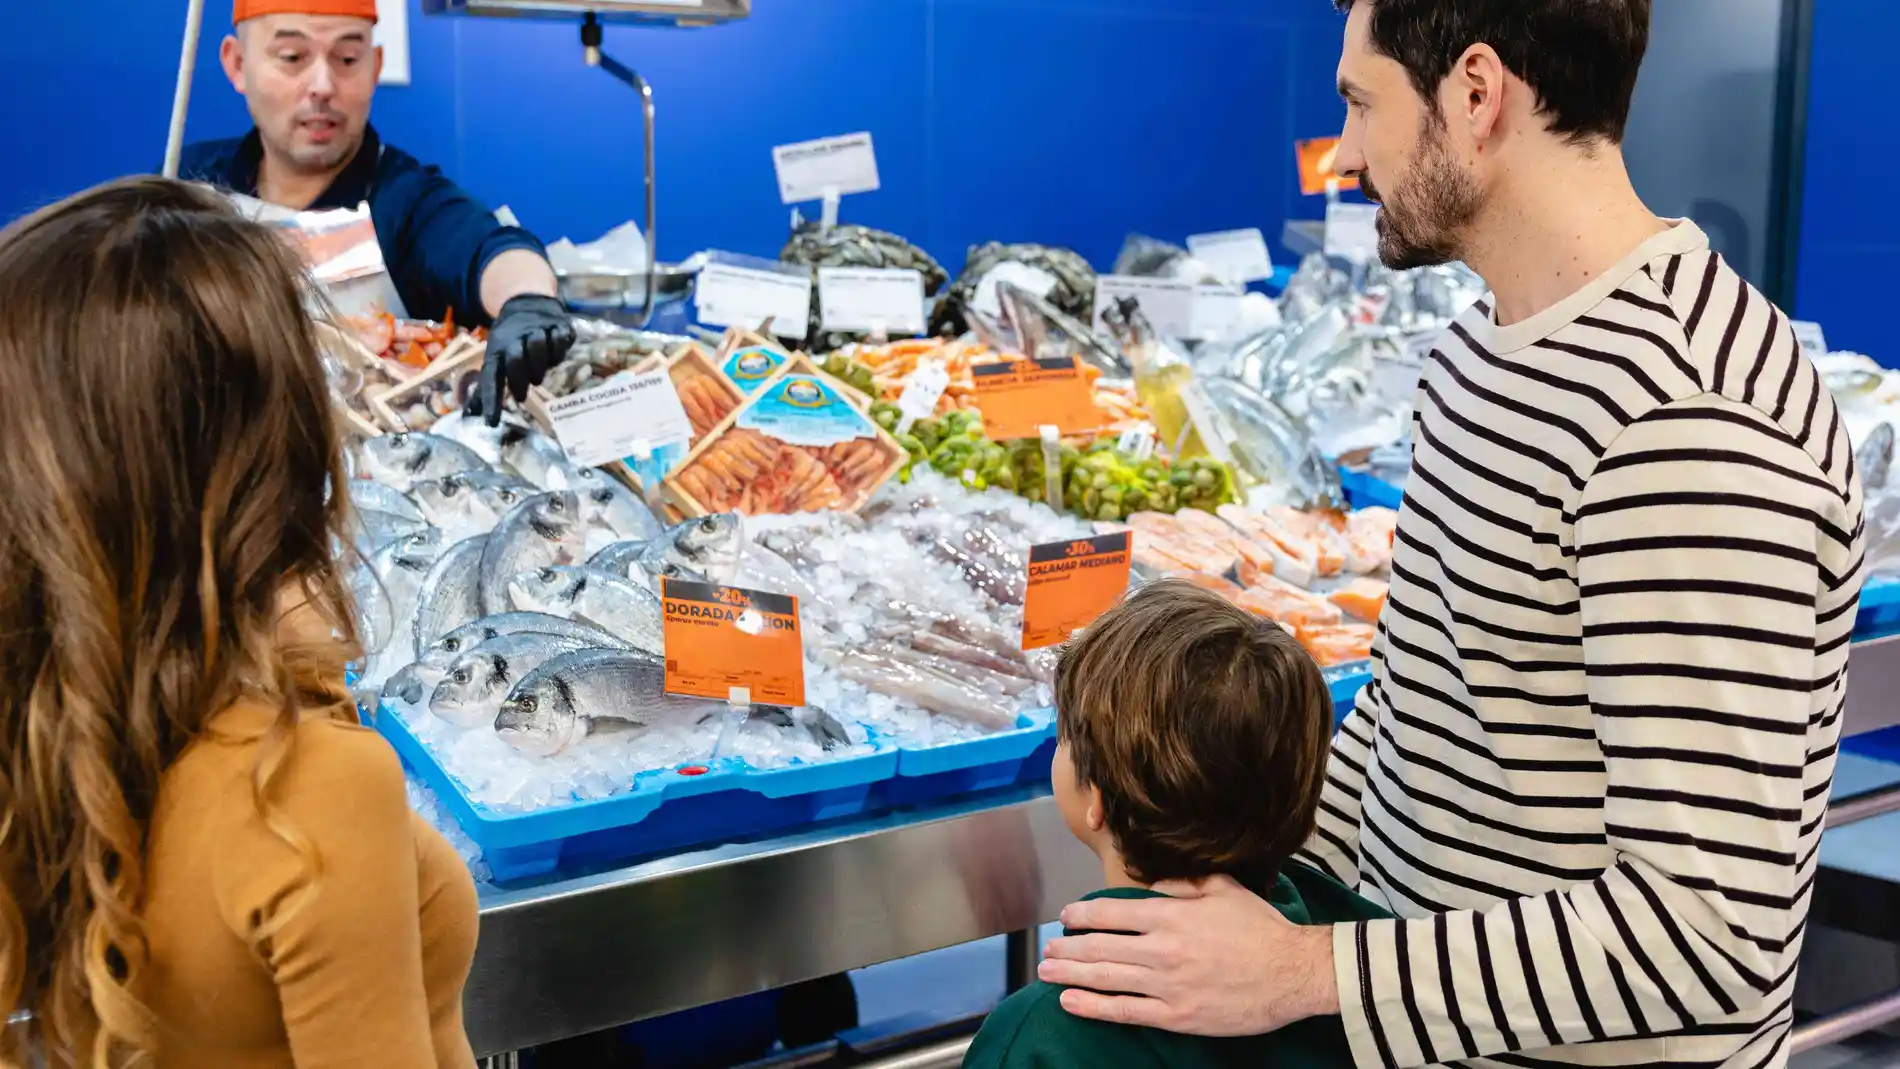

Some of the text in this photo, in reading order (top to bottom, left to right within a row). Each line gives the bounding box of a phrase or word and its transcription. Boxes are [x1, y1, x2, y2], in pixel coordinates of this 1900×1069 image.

[1029, 555, 1125, 576] CALAMAR MEDIANO
[666, 602, 734, 621] DORADA
